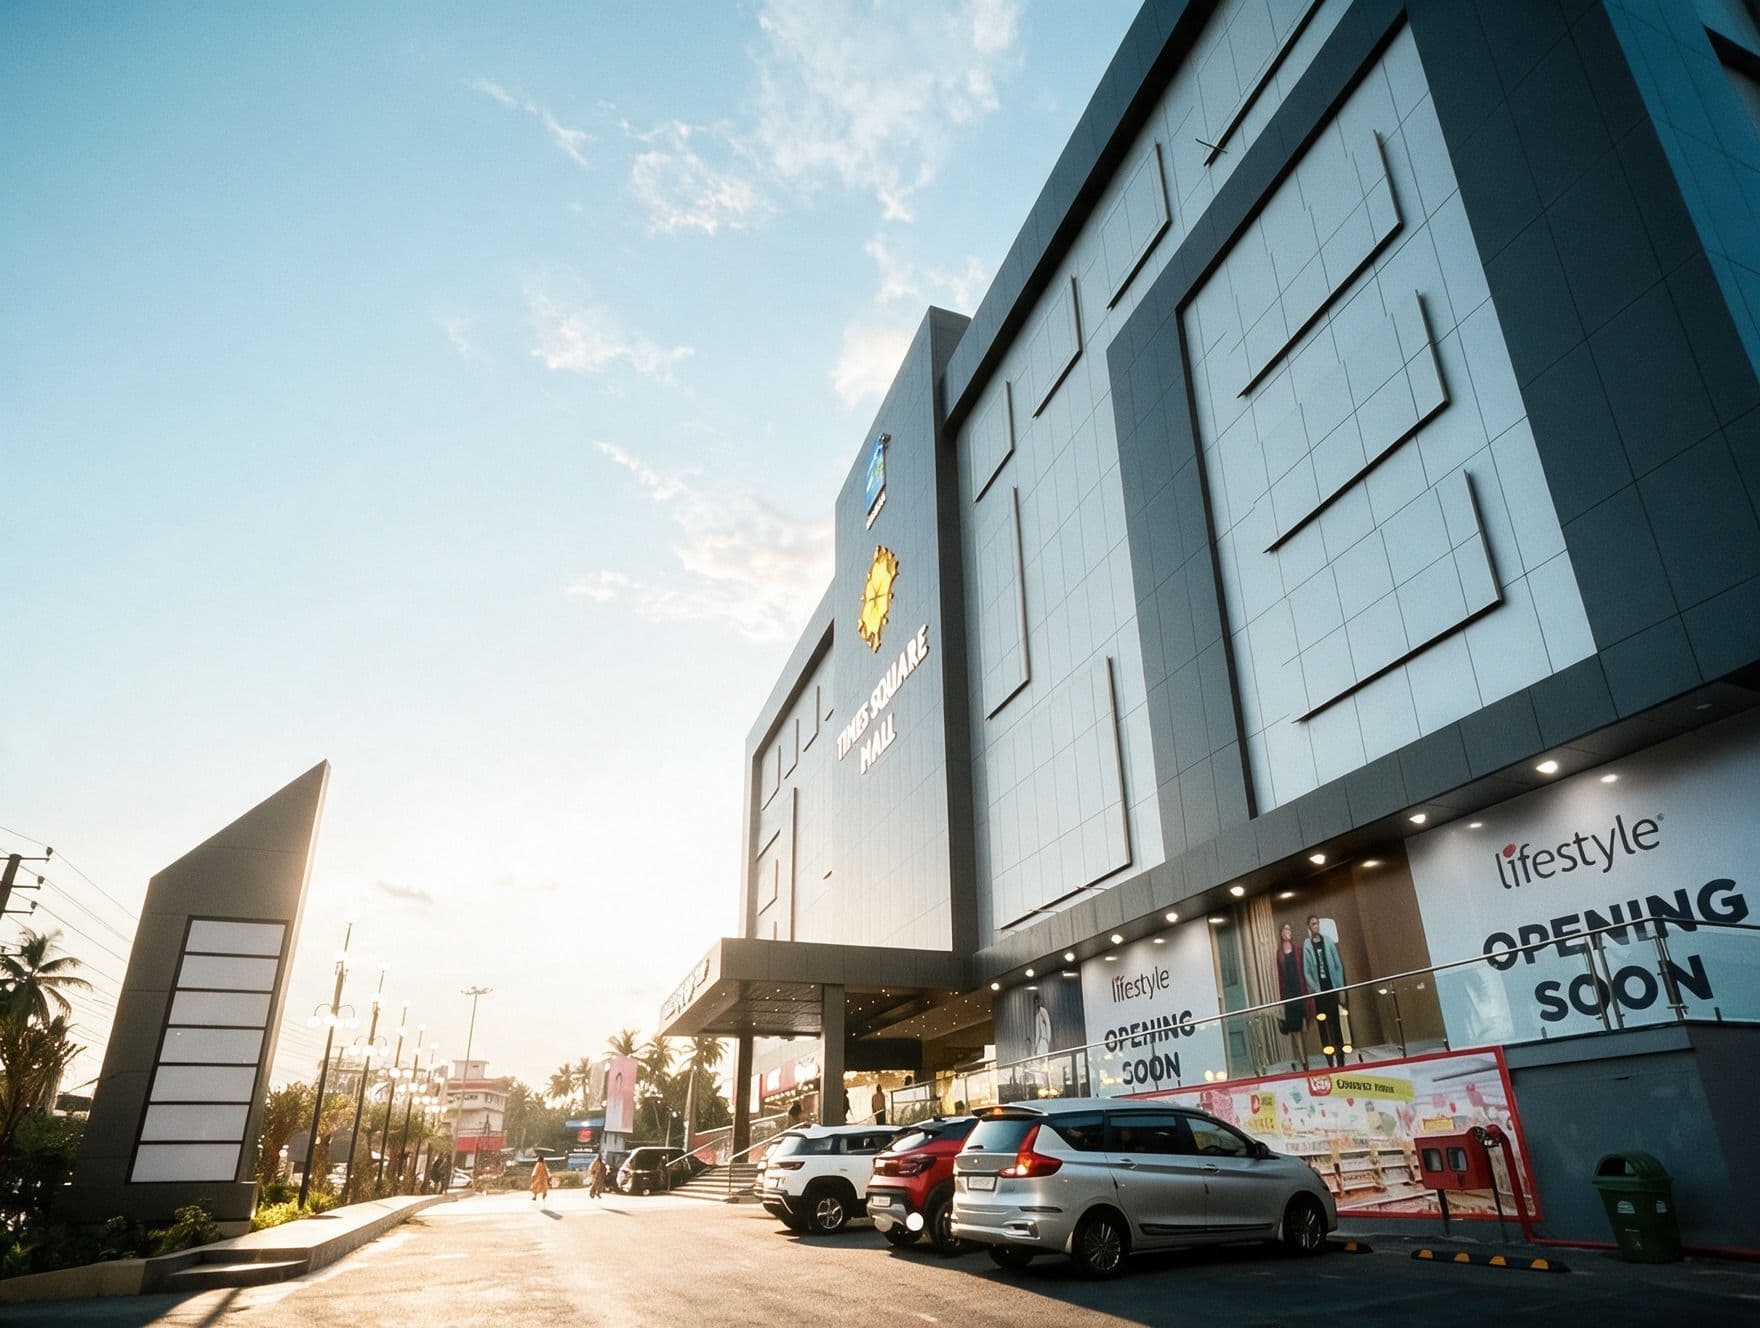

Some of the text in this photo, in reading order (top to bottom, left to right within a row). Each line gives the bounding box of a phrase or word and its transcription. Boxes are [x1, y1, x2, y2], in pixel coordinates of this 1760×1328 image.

[837, 623, 929, 761] TIMES SQUARE
[860, 711, 897, 775] MALL
[1495, 814, 1660, 888] lifestyle
[1483, 878, 1749, 971] OPENING
[1112, 966, 1169, 1003] lifestyle
[1534, 954, 1713, 1022] SOON
[1104, 1010, 1196, 1053] OPENING
[1122, 1052, 1181, 1085] SOON
